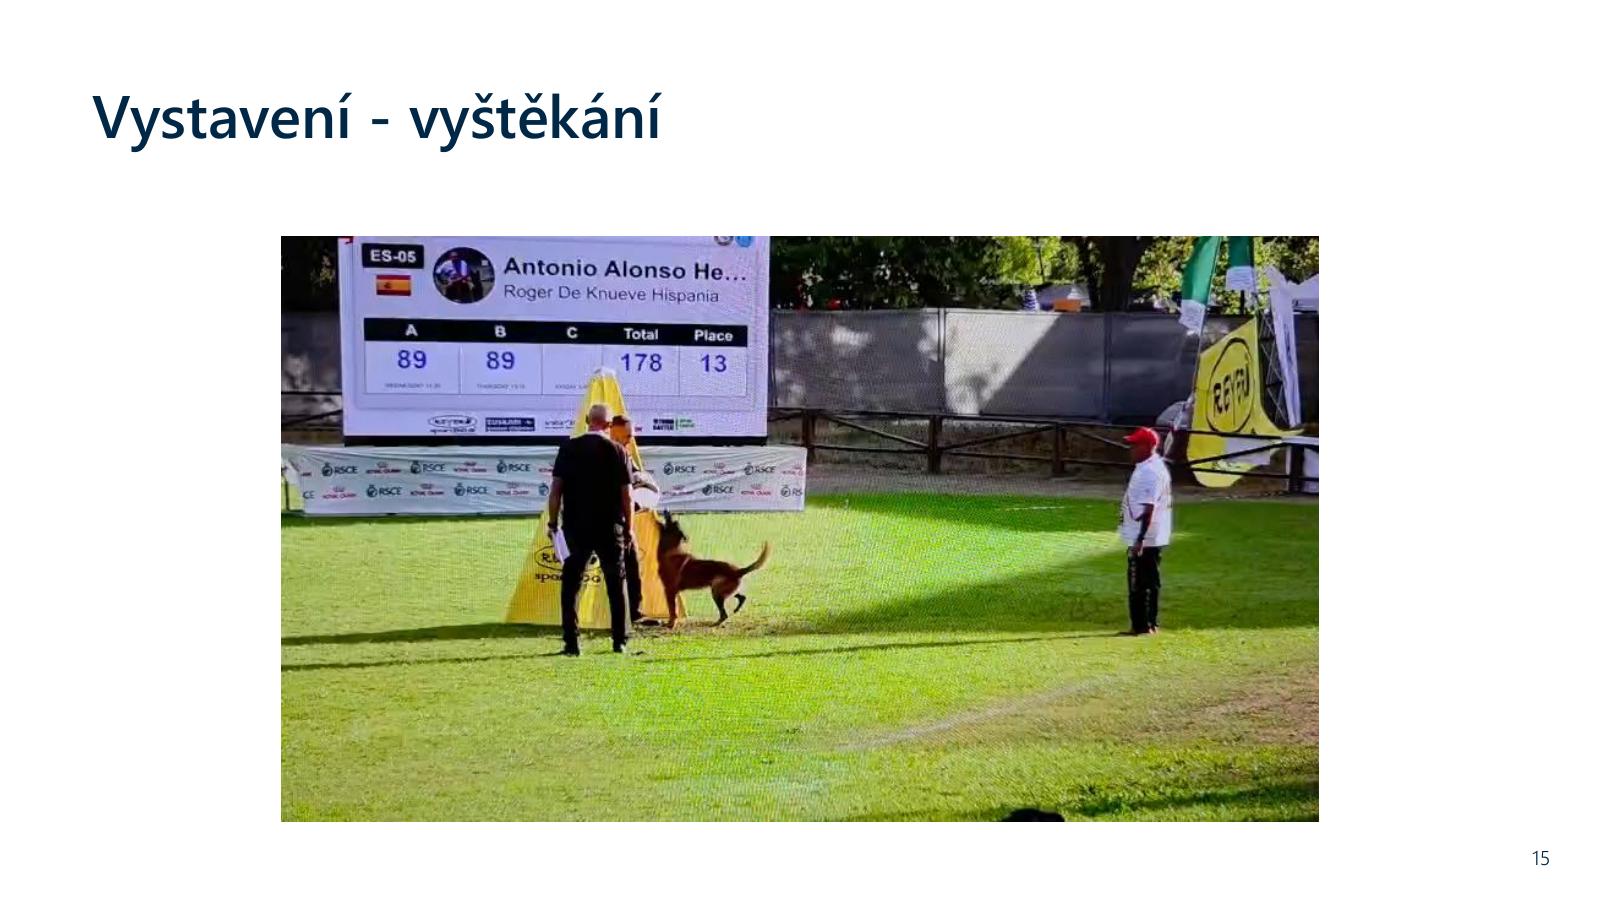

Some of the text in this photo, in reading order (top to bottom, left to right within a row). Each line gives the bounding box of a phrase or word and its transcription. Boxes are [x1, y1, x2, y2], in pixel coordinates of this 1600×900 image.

[370, 249, 417, 263] ES-05
[504, 257, 597, 277] Antonio
[604, 260, 686, 279] Alonso
[504, 285, 719, 304] Roger De Knueve Hispania
[405, 324, 418, 336] A
[494, 325, 507, 338] B
[566, 326, 579, 339] C
[624, 327, 659, 340] Total
[694, 329, 734, 342] Place
[397, 350, 427, 369] 89
[486, 351, 515, 370] 89
[620, 353, 663, 372] 178
[701, 354, 727, 372] 13
[422, 464, 445, 472] RSCE
[508, 464, 531, 472] RSCE
[673, 465, 697, 474] RSCE
[380, 487, 401, 495] RSCE
